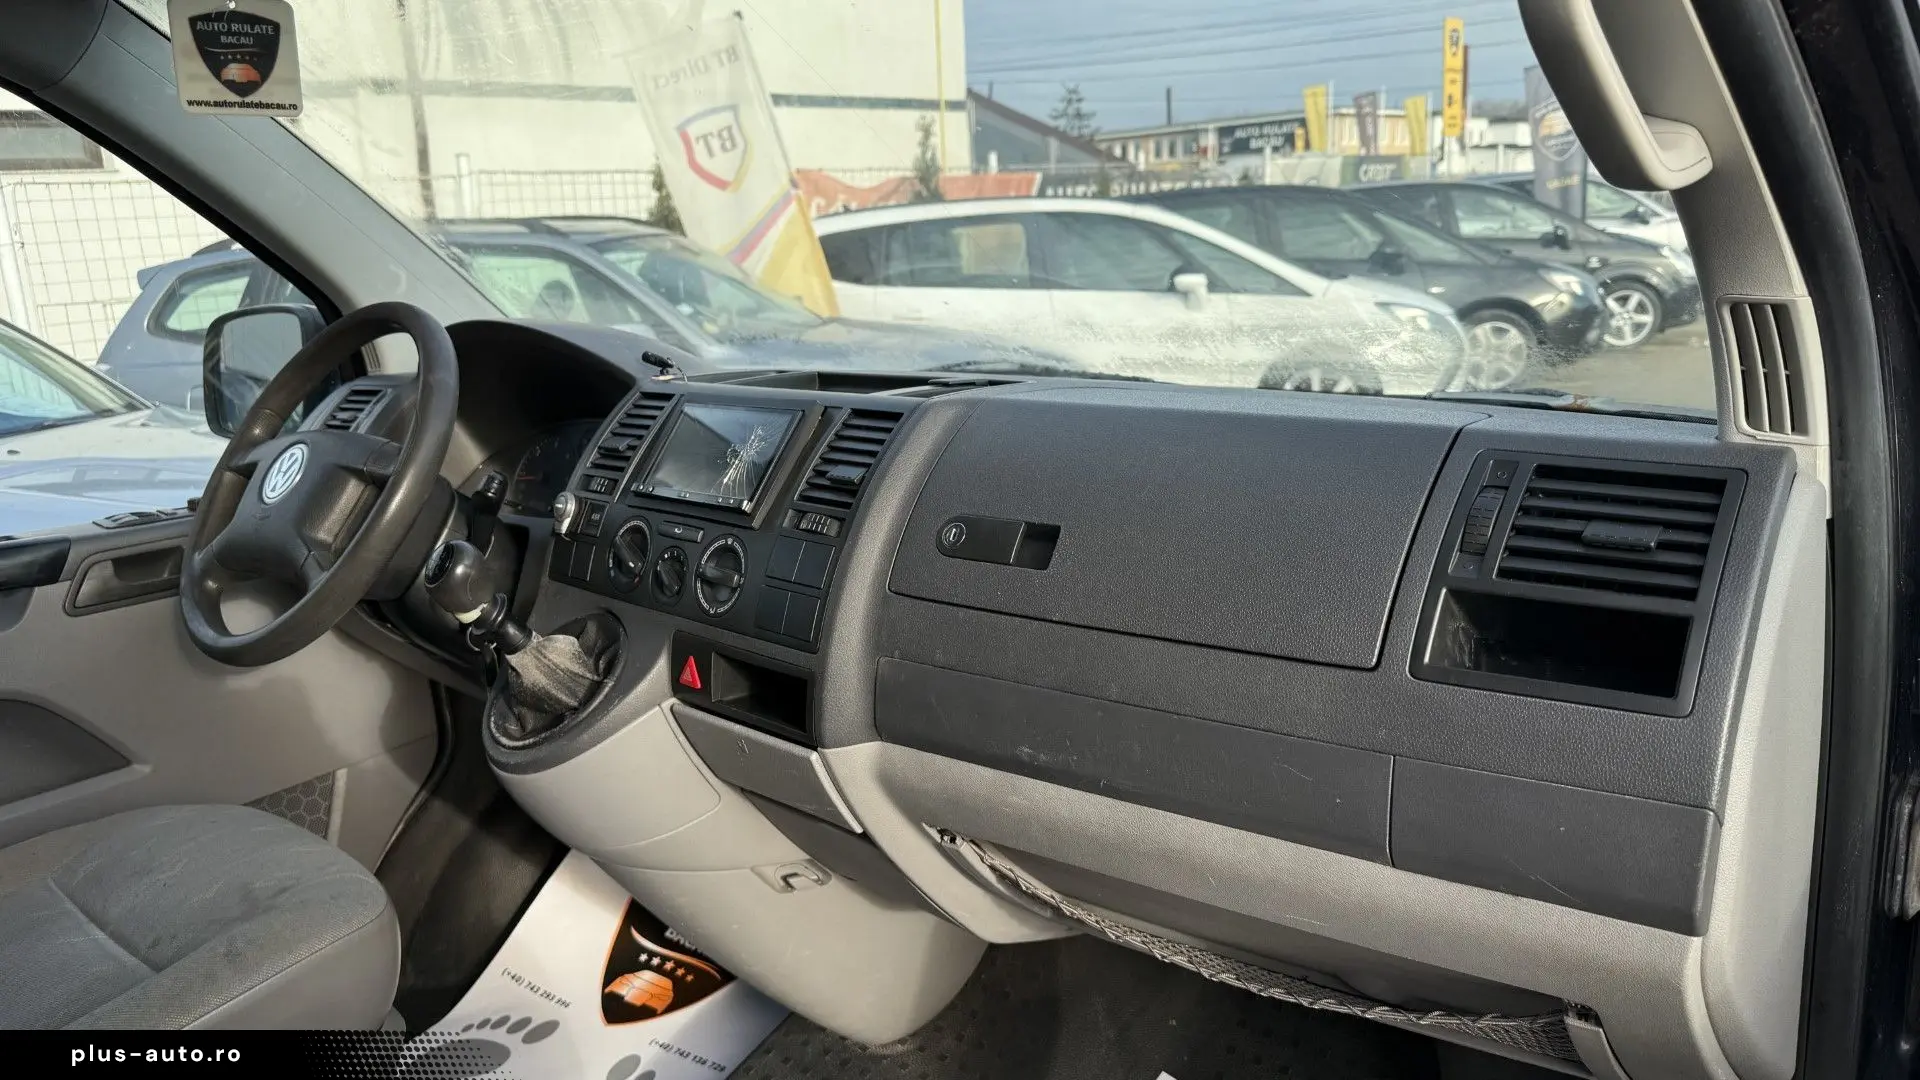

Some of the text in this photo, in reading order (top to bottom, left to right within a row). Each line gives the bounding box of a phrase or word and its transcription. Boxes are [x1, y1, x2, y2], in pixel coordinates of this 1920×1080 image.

[196, 21, 275, 35] AUTO RULATE
[220, 35, 254, 45] BACAU
[186, 99, 298, 111] www.autorulatebacau.ro
